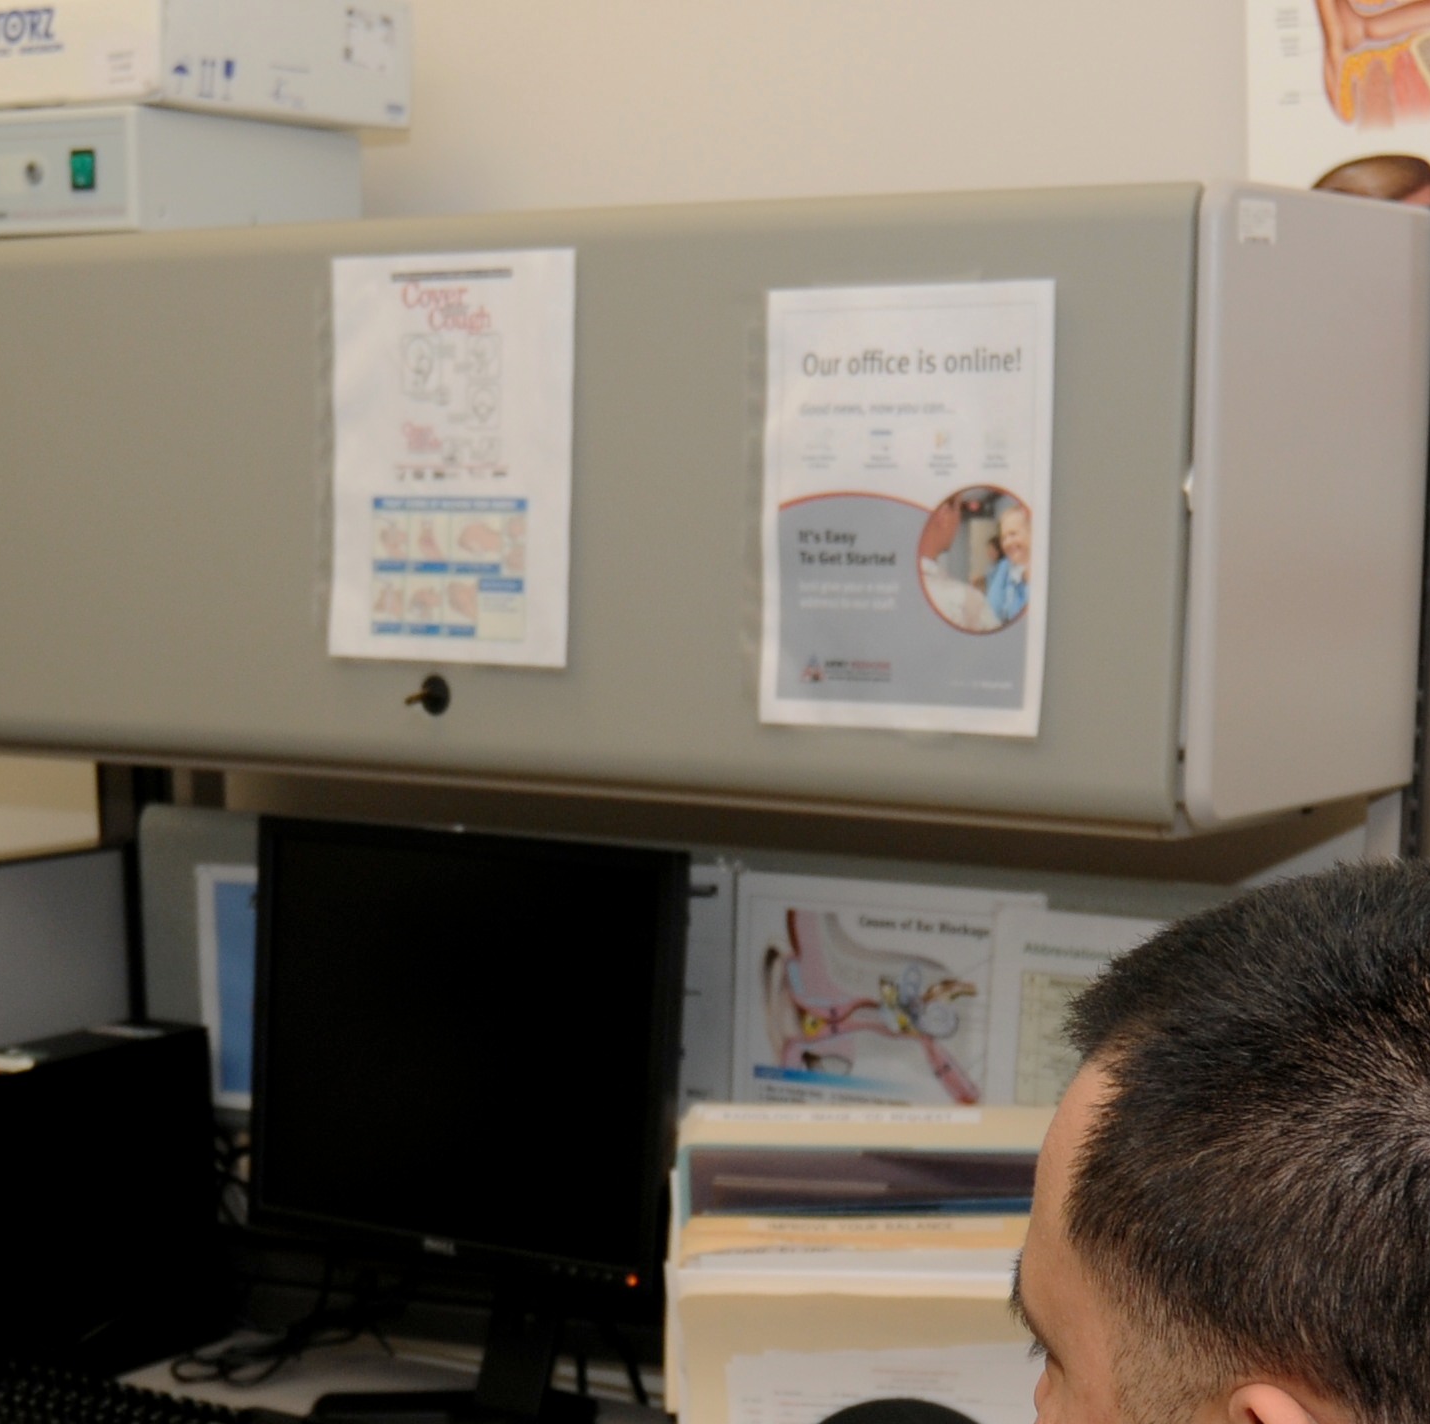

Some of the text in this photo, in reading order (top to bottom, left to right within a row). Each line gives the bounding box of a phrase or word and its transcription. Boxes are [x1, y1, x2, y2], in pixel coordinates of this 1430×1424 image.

[400, 280, 469, 310] Cover
[426, 304, 492, 336] Cough
[802, 347, 1023, 377] Our office is online!
[798, 529, 857, 547] It's Easy
[799, 551, 897, 566] To Get Started
[859, 916, 897, 930] Causes
[899, 917, 913, 930] of
[938, 920, 990, 940] Blockage
